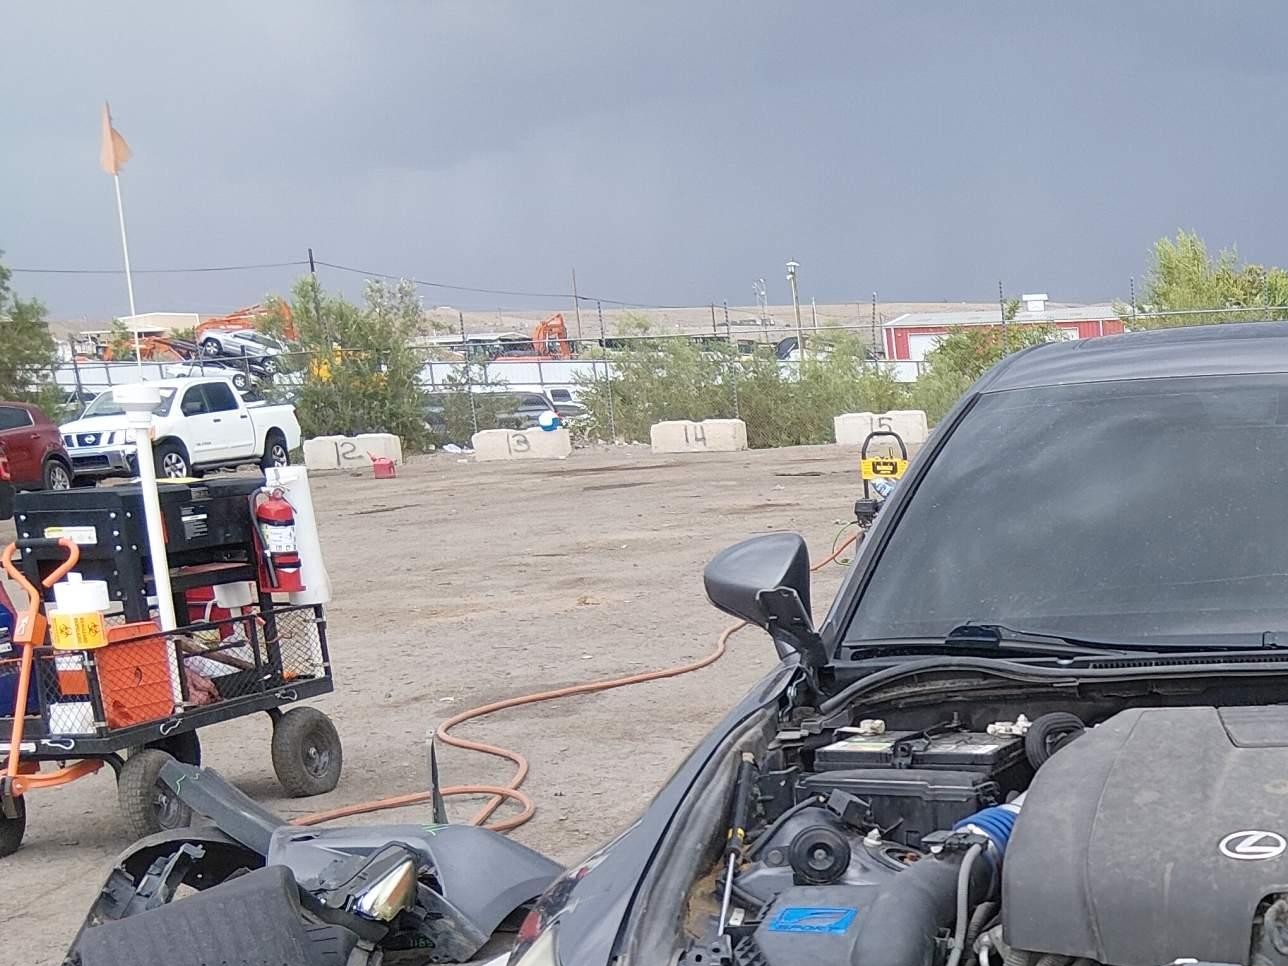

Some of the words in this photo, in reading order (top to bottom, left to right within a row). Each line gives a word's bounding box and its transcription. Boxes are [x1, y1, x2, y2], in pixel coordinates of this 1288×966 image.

[506, 431, 530, 456] 13
[684, 420, 707, 447] 14
[334, 441, 365, 466] 12
